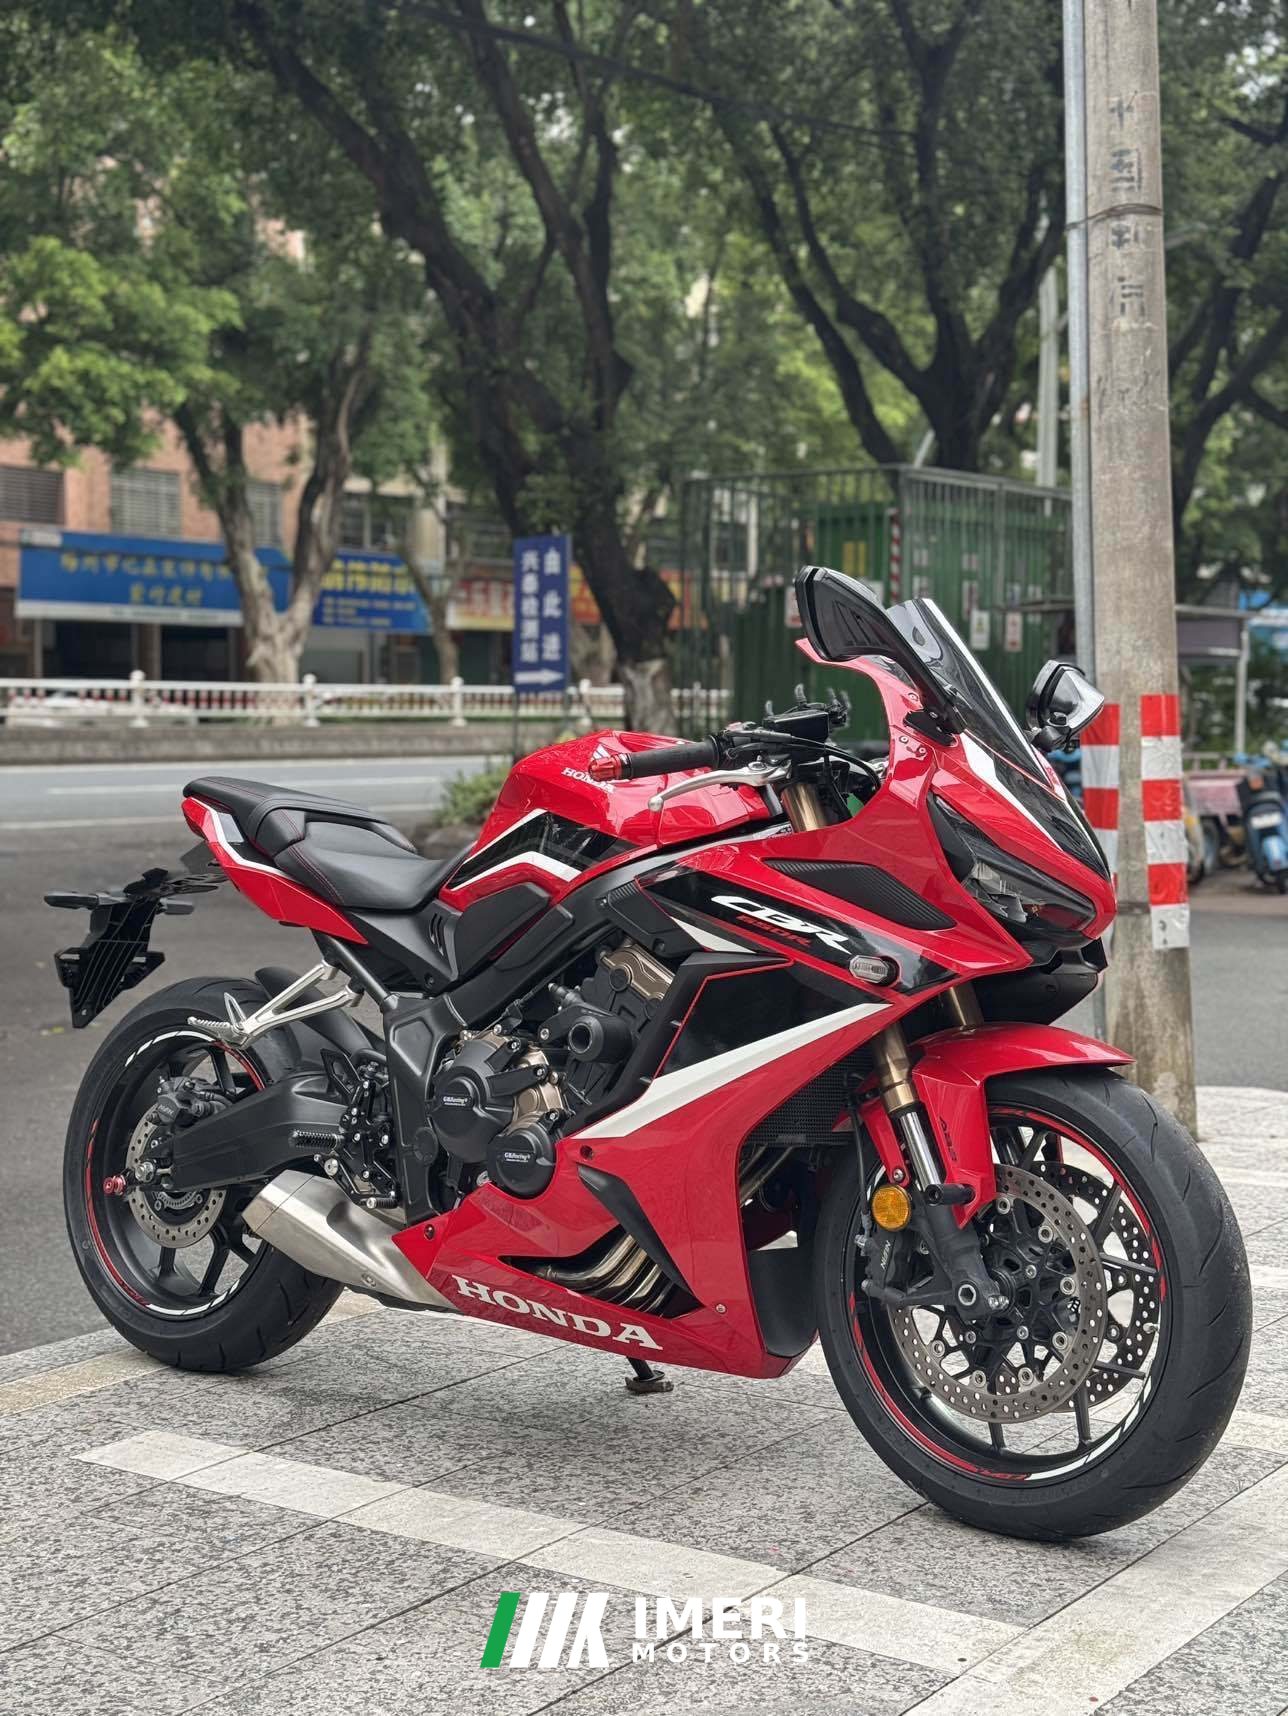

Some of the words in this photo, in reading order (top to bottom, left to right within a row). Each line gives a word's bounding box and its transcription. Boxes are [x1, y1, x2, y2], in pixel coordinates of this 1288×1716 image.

[543, 547, 562, 661] 由此进
[711, 895, 852, 955] CBR
[736, 914, 812, 948] 650R
[451, 1274, 664, 1350] HONDA
